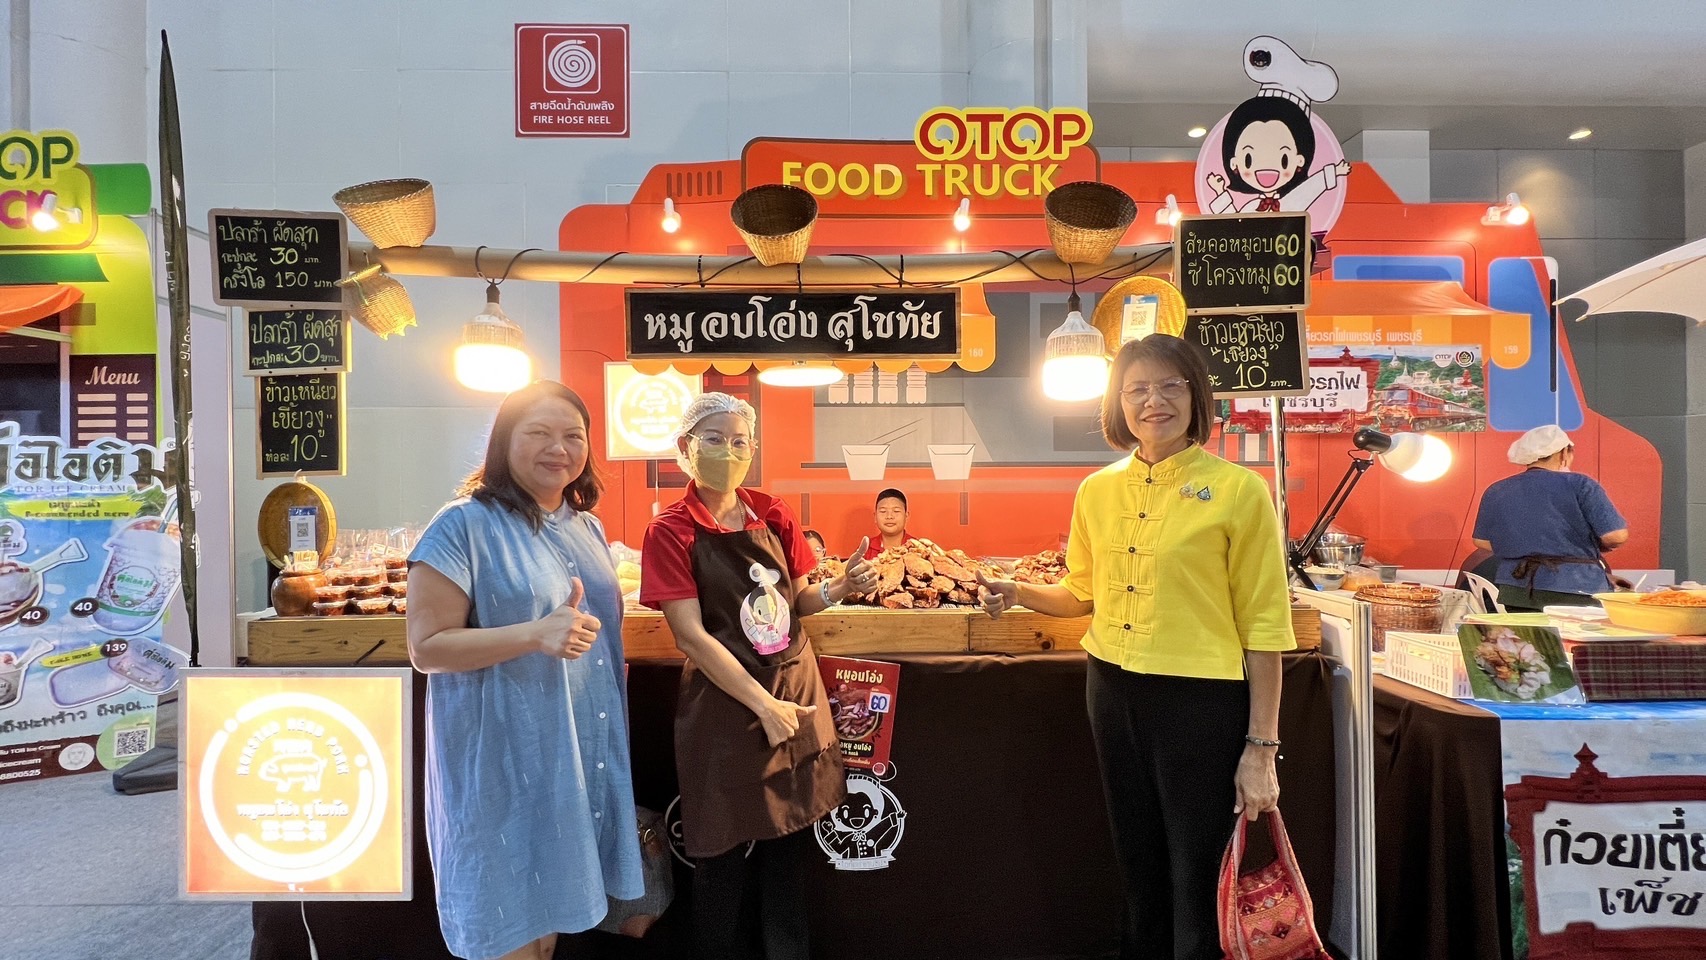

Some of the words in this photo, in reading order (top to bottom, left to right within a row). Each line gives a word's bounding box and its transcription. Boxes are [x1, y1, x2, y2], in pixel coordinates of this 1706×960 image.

[529, 97, 615, 111] สายฉีดน้ำดับเพลิง
[533, 115, 554, 124] FIRE
[557, 115, 584, 124] HOSE
[587, 115, 611, 124] REEL
[917, 112, 1088, 155] OTOP
[782, 161, 903, 197] FOOD
[916, 163, 1062, 197] TRUCK
[219, 217, 268, 243] ปลาร้า
[273, 220, 319, 250] ผัดสุก
[270, 247, 299, 265] 30
[275, 272, 309, 288] 150
[251, 311, 297, 344] ปลาร้า
[644, 310, 695, 353] หมู
[700, 295, 818, 342] อบโอ่ง
[827, 295, 944, 351] สุโขทัย
[284, 342, 320, 364] 30
[85, 366, 141, 385] Menu
[1232, 363, 1267, 389] 10
[265, 377, 337, 402] ข้าวเหนียว
[22, 610, 41, 620] 40
[74, 601, 93, 612] 40
[106, 642, 127, 652] 139
[836, 669, 884, 684] หมูอบโอ่ง
[870, 694, 888, 711] 60
